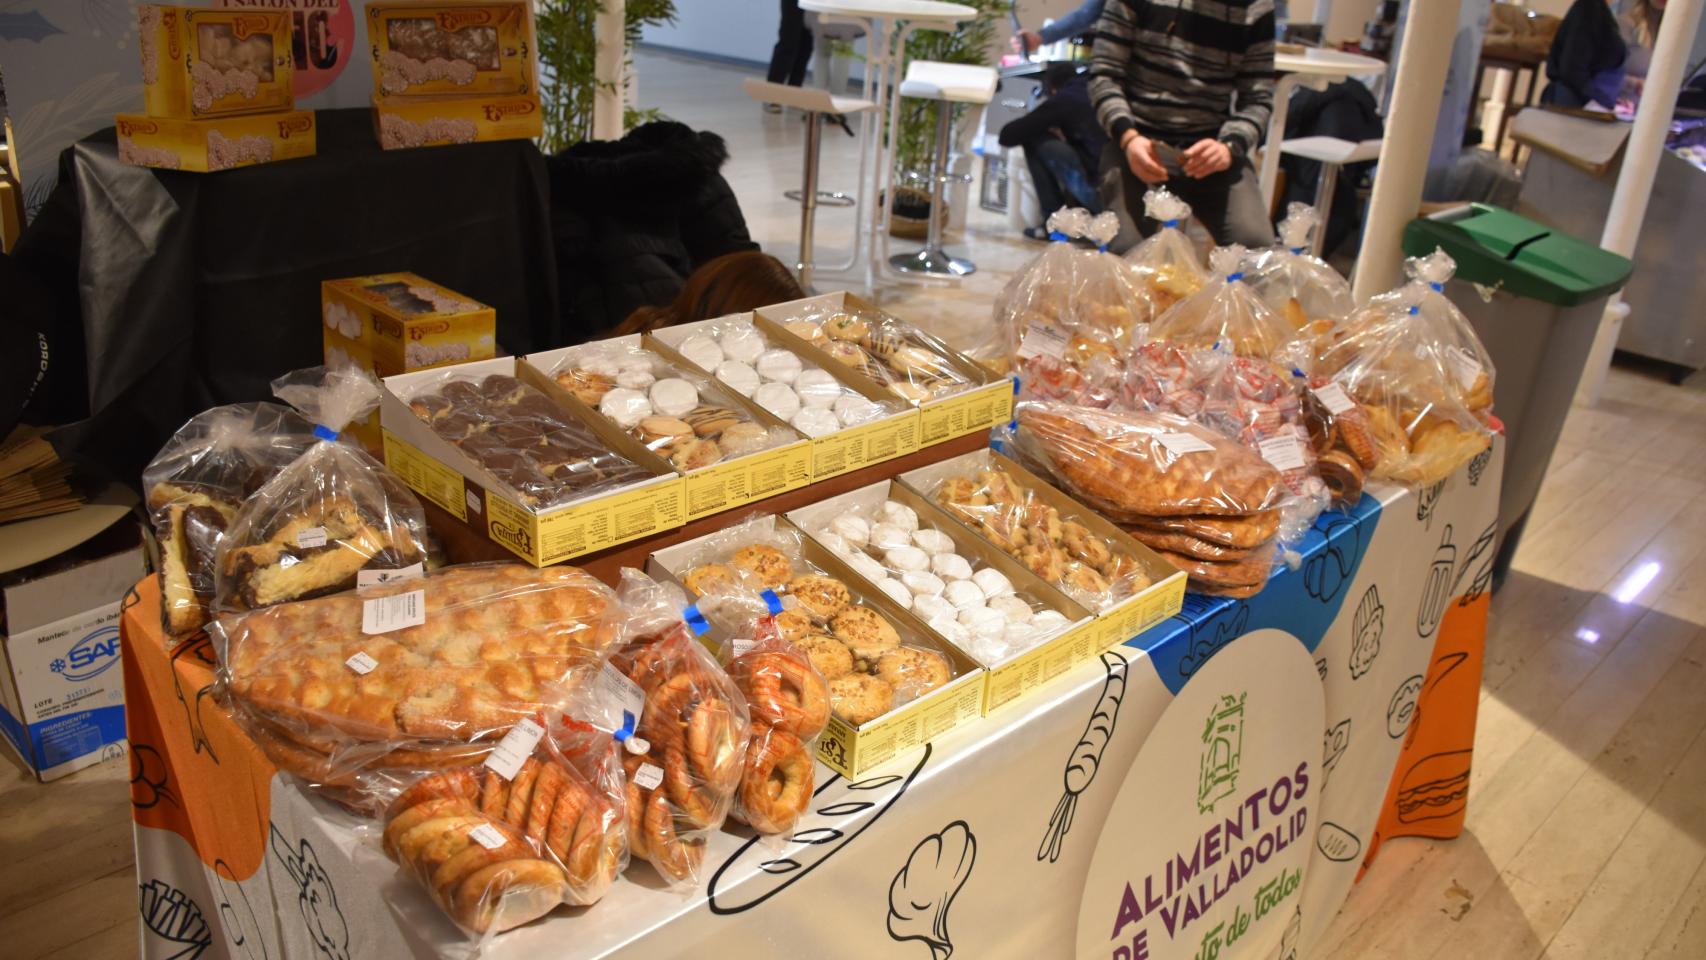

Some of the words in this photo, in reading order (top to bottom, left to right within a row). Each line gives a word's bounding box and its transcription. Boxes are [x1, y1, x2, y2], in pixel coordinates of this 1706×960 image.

[1110, 760, 1309, 941] ALIMENTOS
[1159, 806, 1308, 940] VALLADOLID
[1226, 904, 1252, 947] de
[1254, 867, 1303, 922] todos
